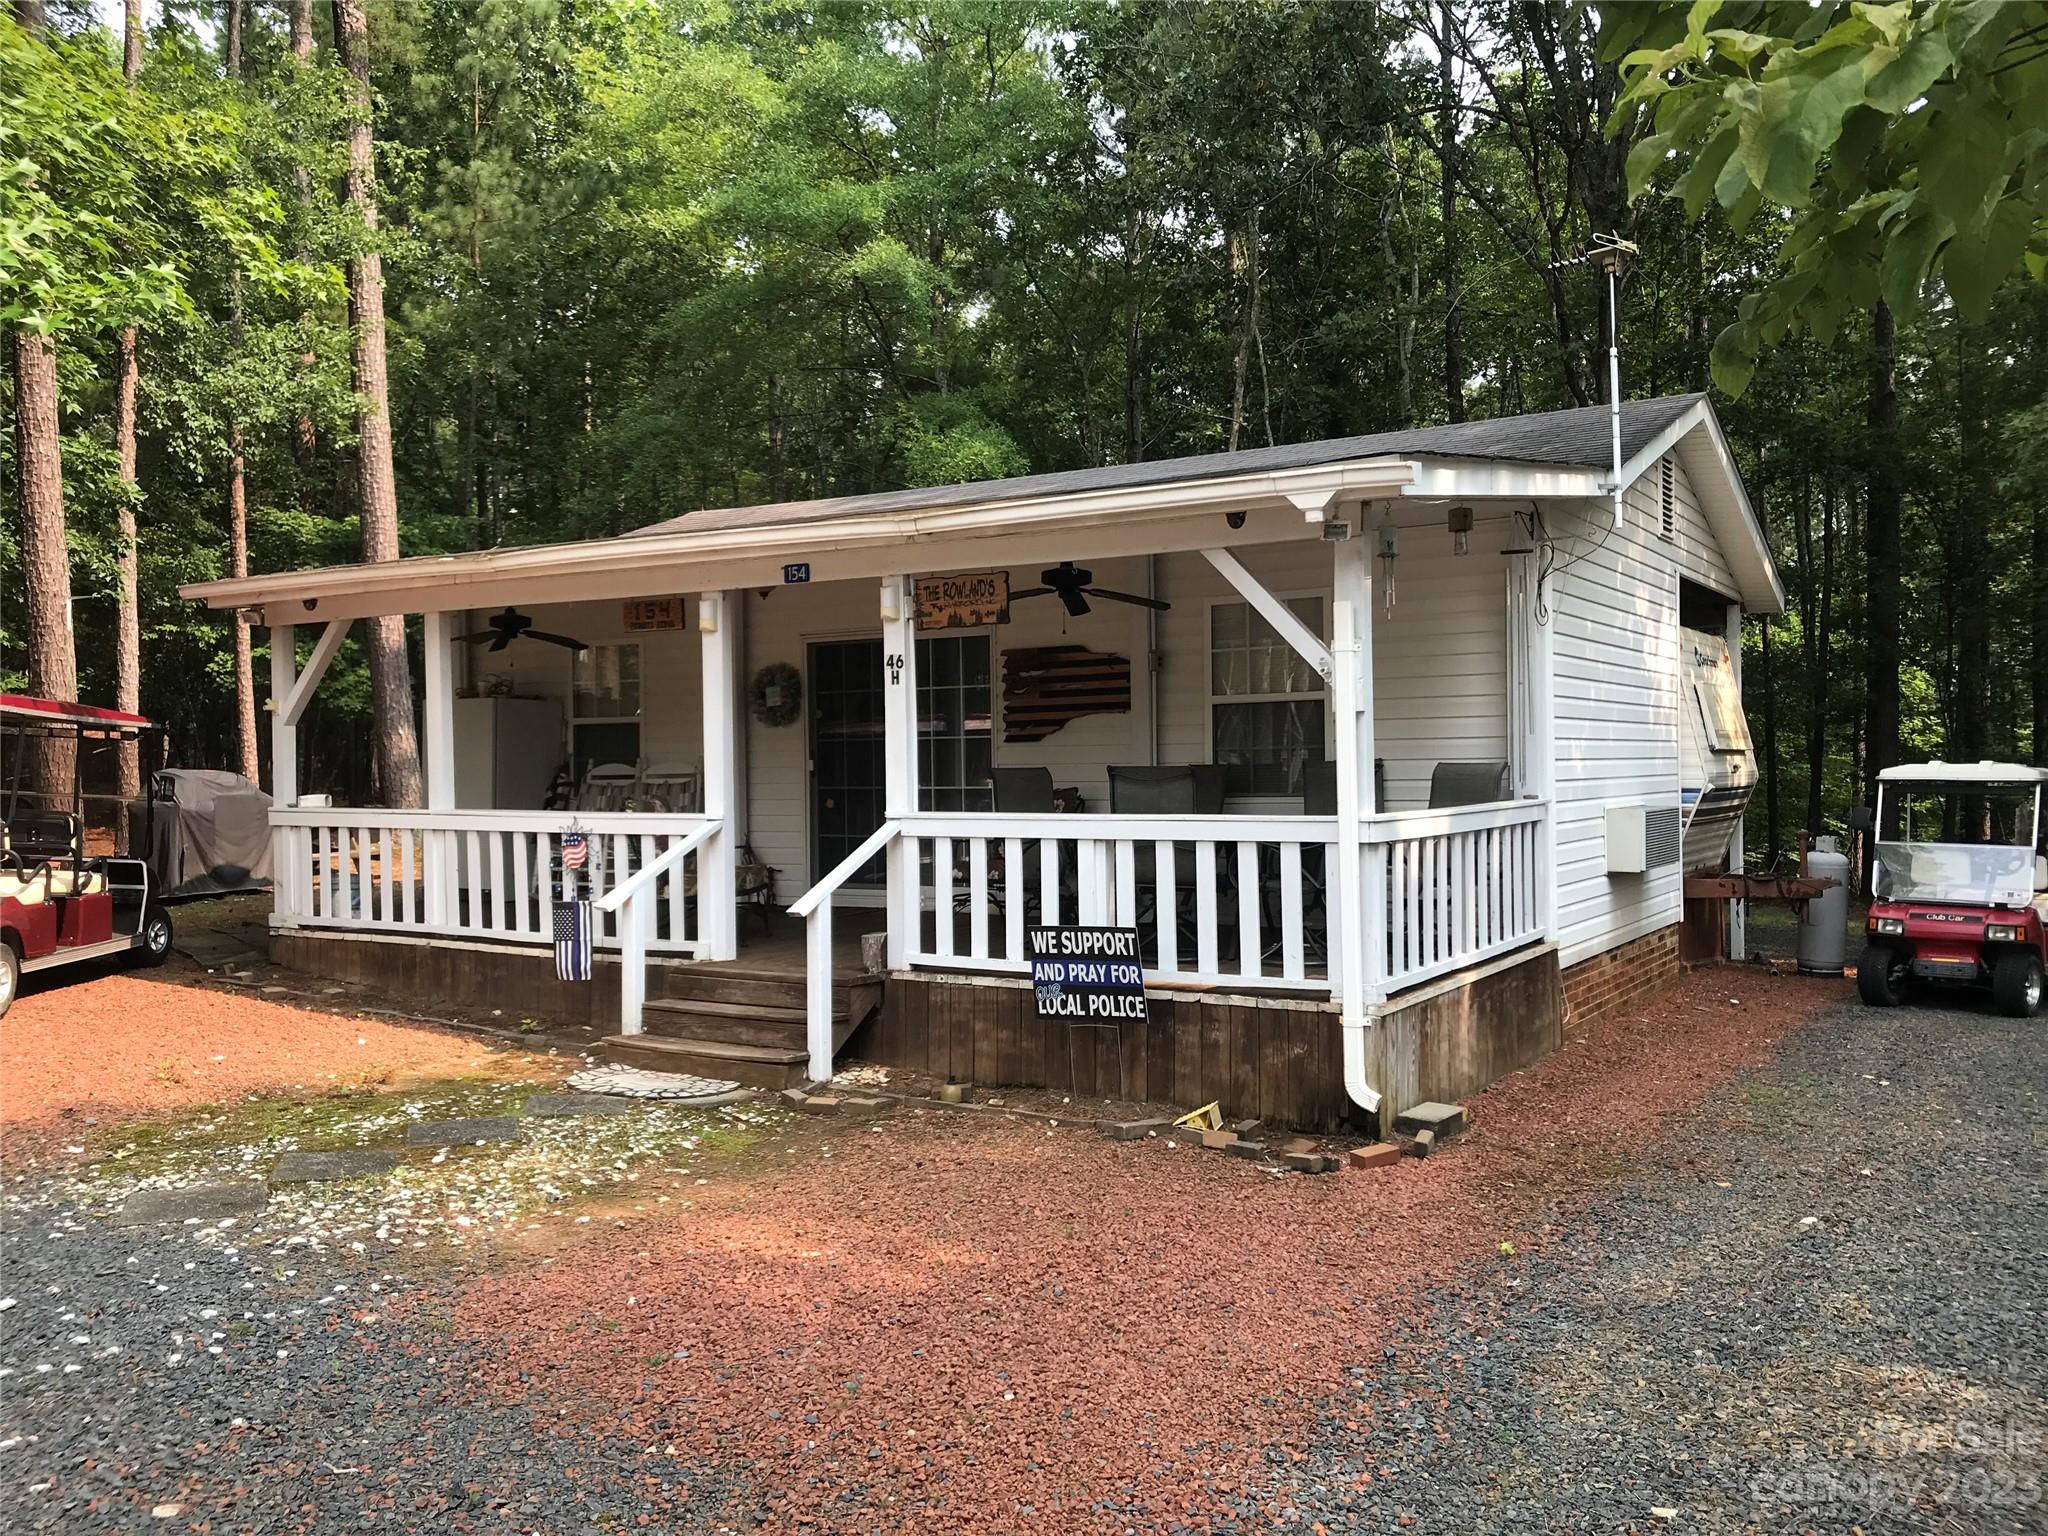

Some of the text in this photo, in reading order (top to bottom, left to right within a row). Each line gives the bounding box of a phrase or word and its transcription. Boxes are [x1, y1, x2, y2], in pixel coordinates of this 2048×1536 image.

[788, 565, 806, 581] 154
[923, 578, 995, 601] THE ROWLAND'S
[633, 601, 670, 620] 154
[886, 654, 904, 669] 46
[891, 671, 899, 685] H
[1031, 931, 1135, 956] WE SUPPORT
[1035, 963, 1141, 984] AND PRAY FOR
[1038, 994, 1145, 1018] LOCAL POLICE
